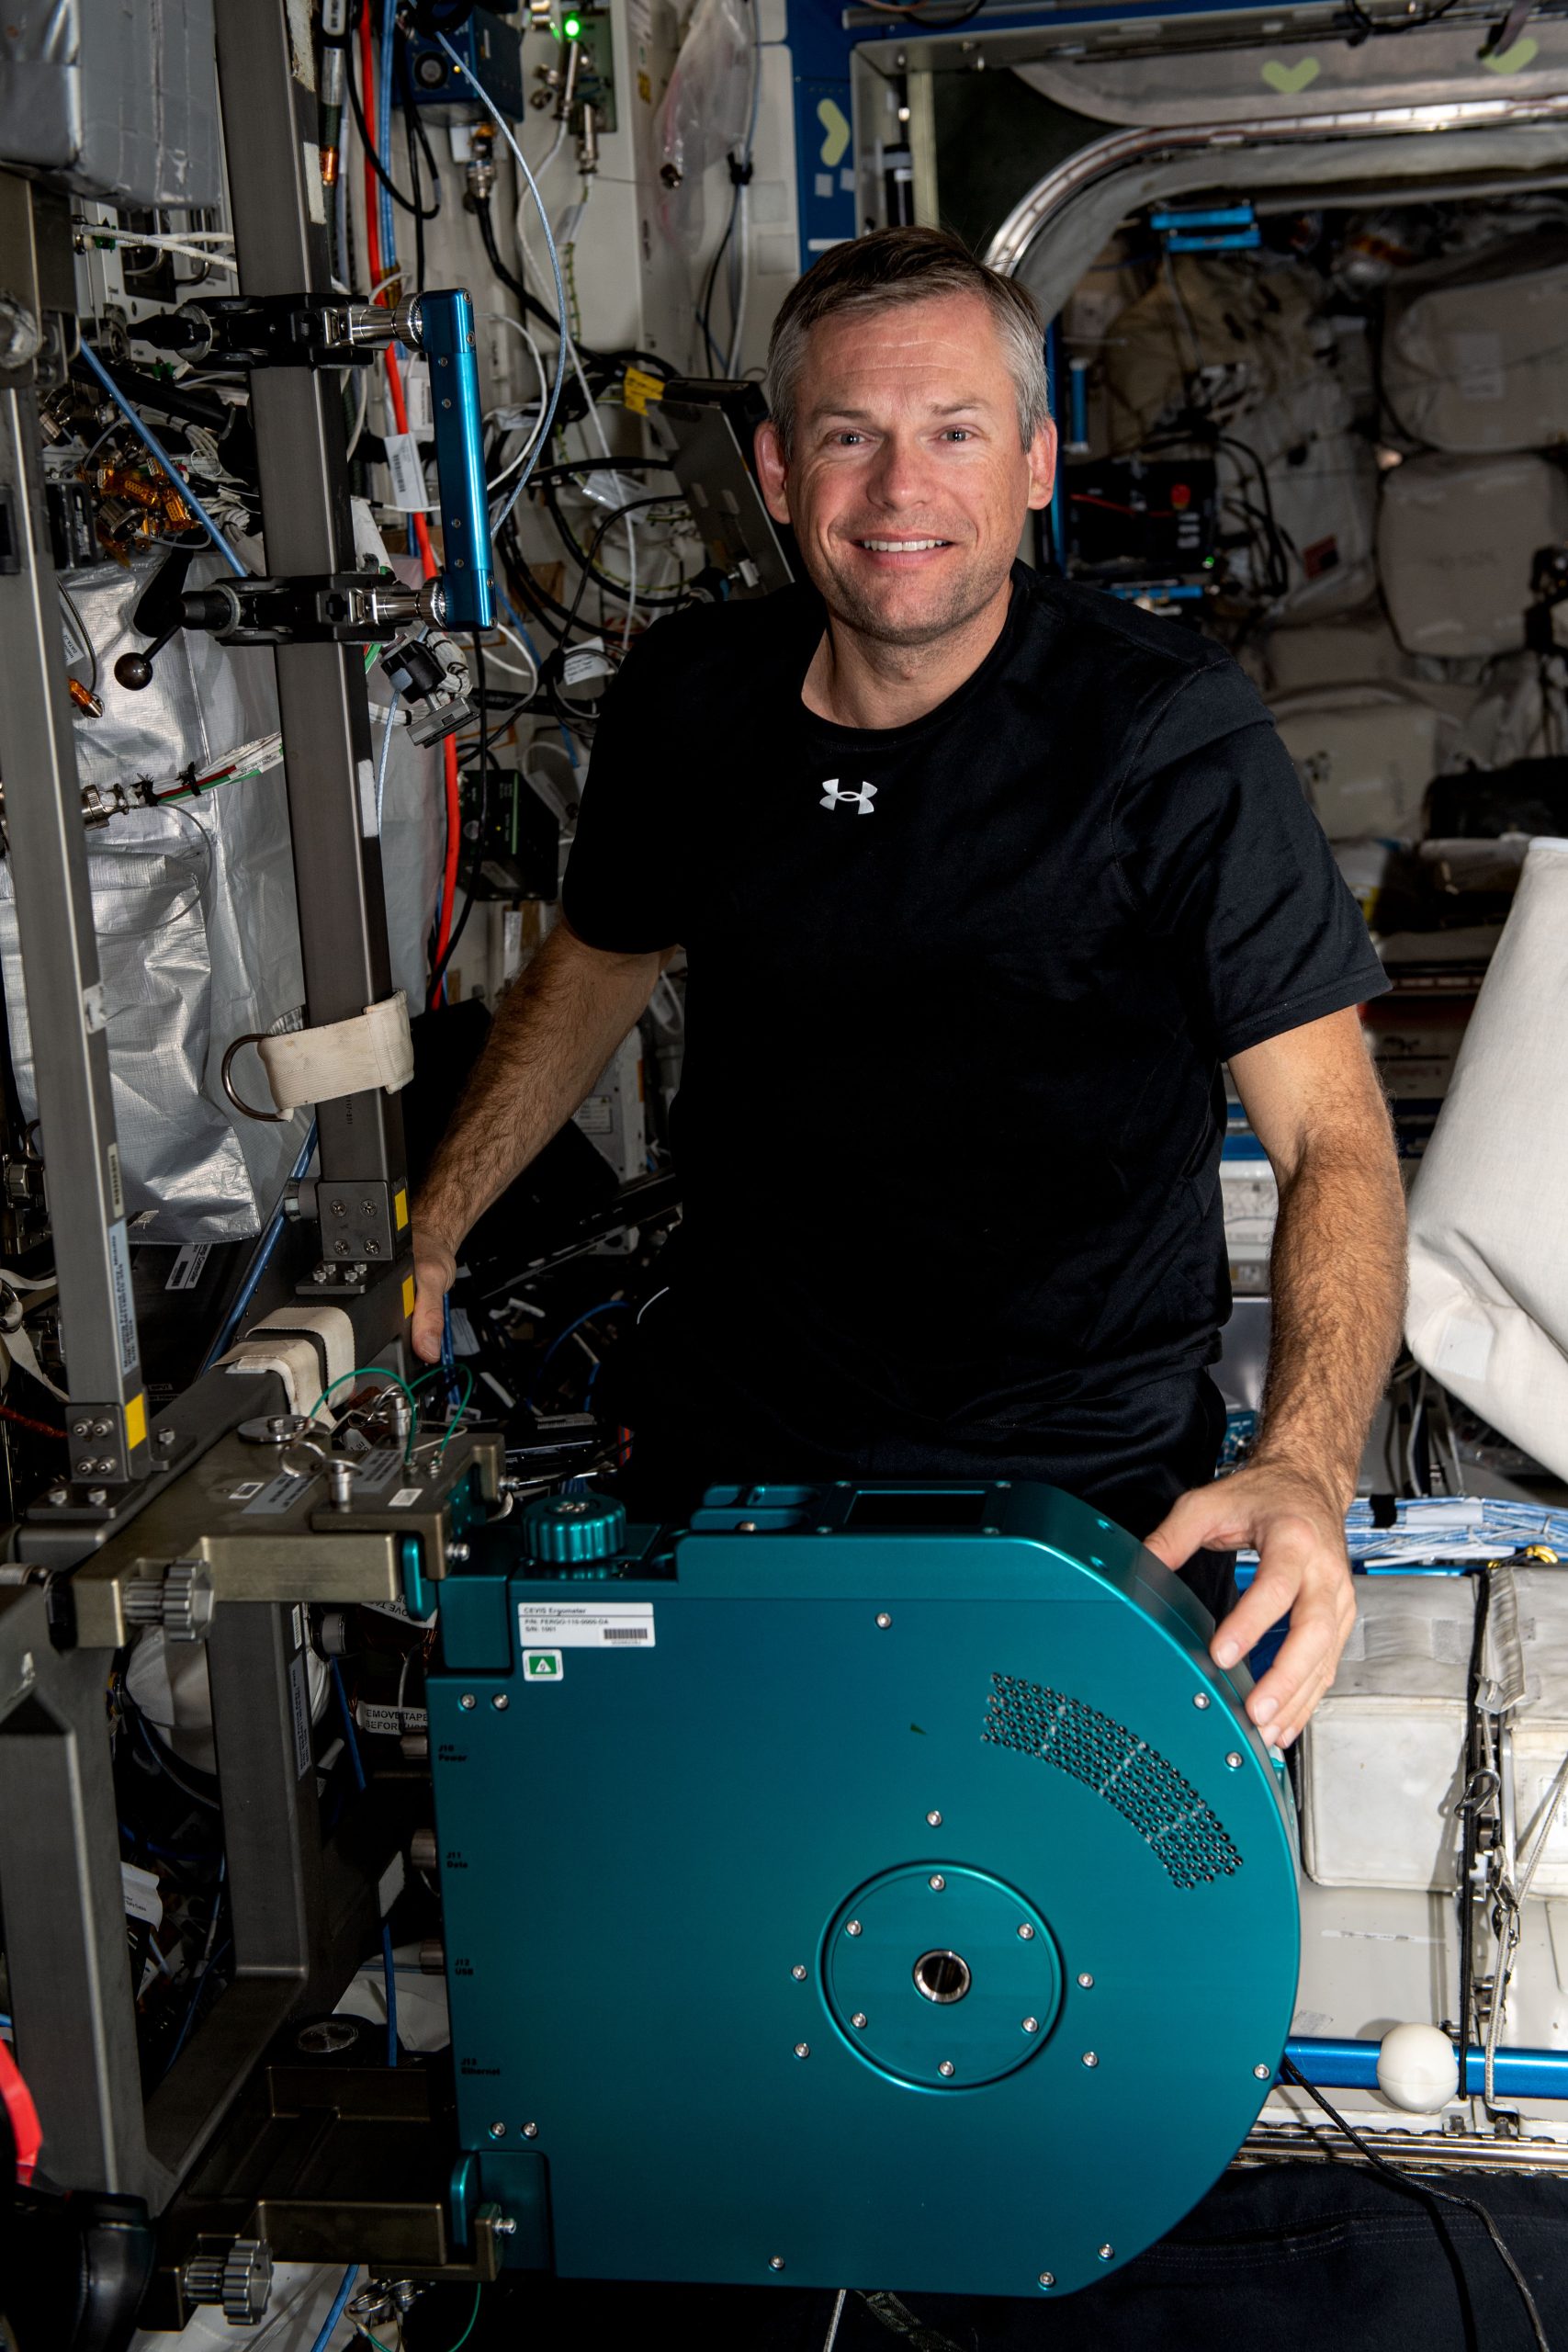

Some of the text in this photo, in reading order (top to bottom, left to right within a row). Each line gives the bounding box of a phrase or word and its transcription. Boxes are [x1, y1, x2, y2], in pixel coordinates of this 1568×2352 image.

[548, 1607, 586, 1616] Ergometer
[367, 1709, 428, 1722] EMOVE TAPE
[438, 1754, 468, 1762] Power
[446, 1851, 461, 1860] J11
[447, 1860, 468, 1869] Data
[456, 1968, 474, 1976] USB
[461, 2066, 501, 2076] Ethernet
